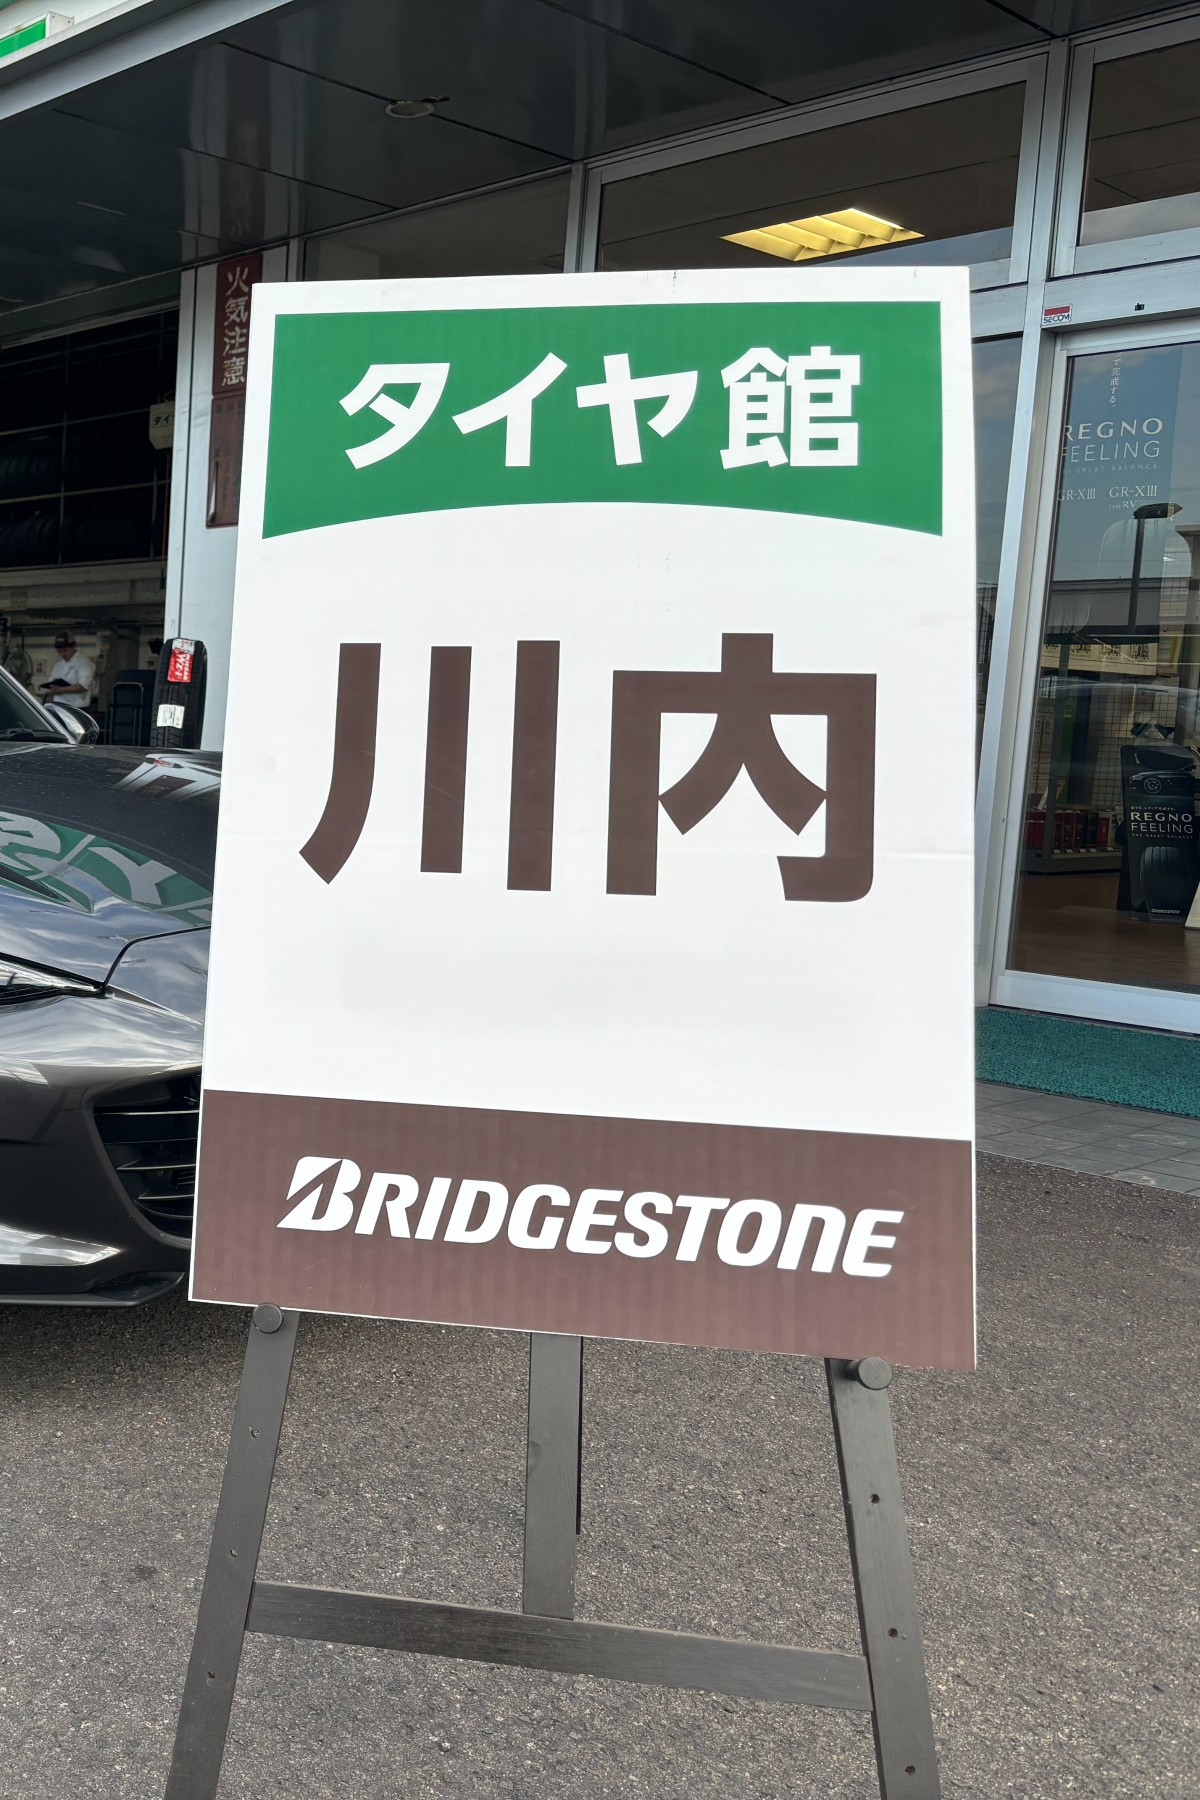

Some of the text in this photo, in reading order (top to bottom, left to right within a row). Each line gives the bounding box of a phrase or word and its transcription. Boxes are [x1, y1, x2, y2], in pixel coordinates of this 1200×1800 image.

[222, 266, 249, 386] 火気注意
[1043, 314, 1070, 324] SECOM
[339, 346, 861, 470] タイヤ館
[299, 633, 877, 902] 川内
[1130, 811, 1193, 823] REGNO
[1131, 822, 1193, 834] FEELING
[277, 1156, 905, 1278] BRIDGESTONE
